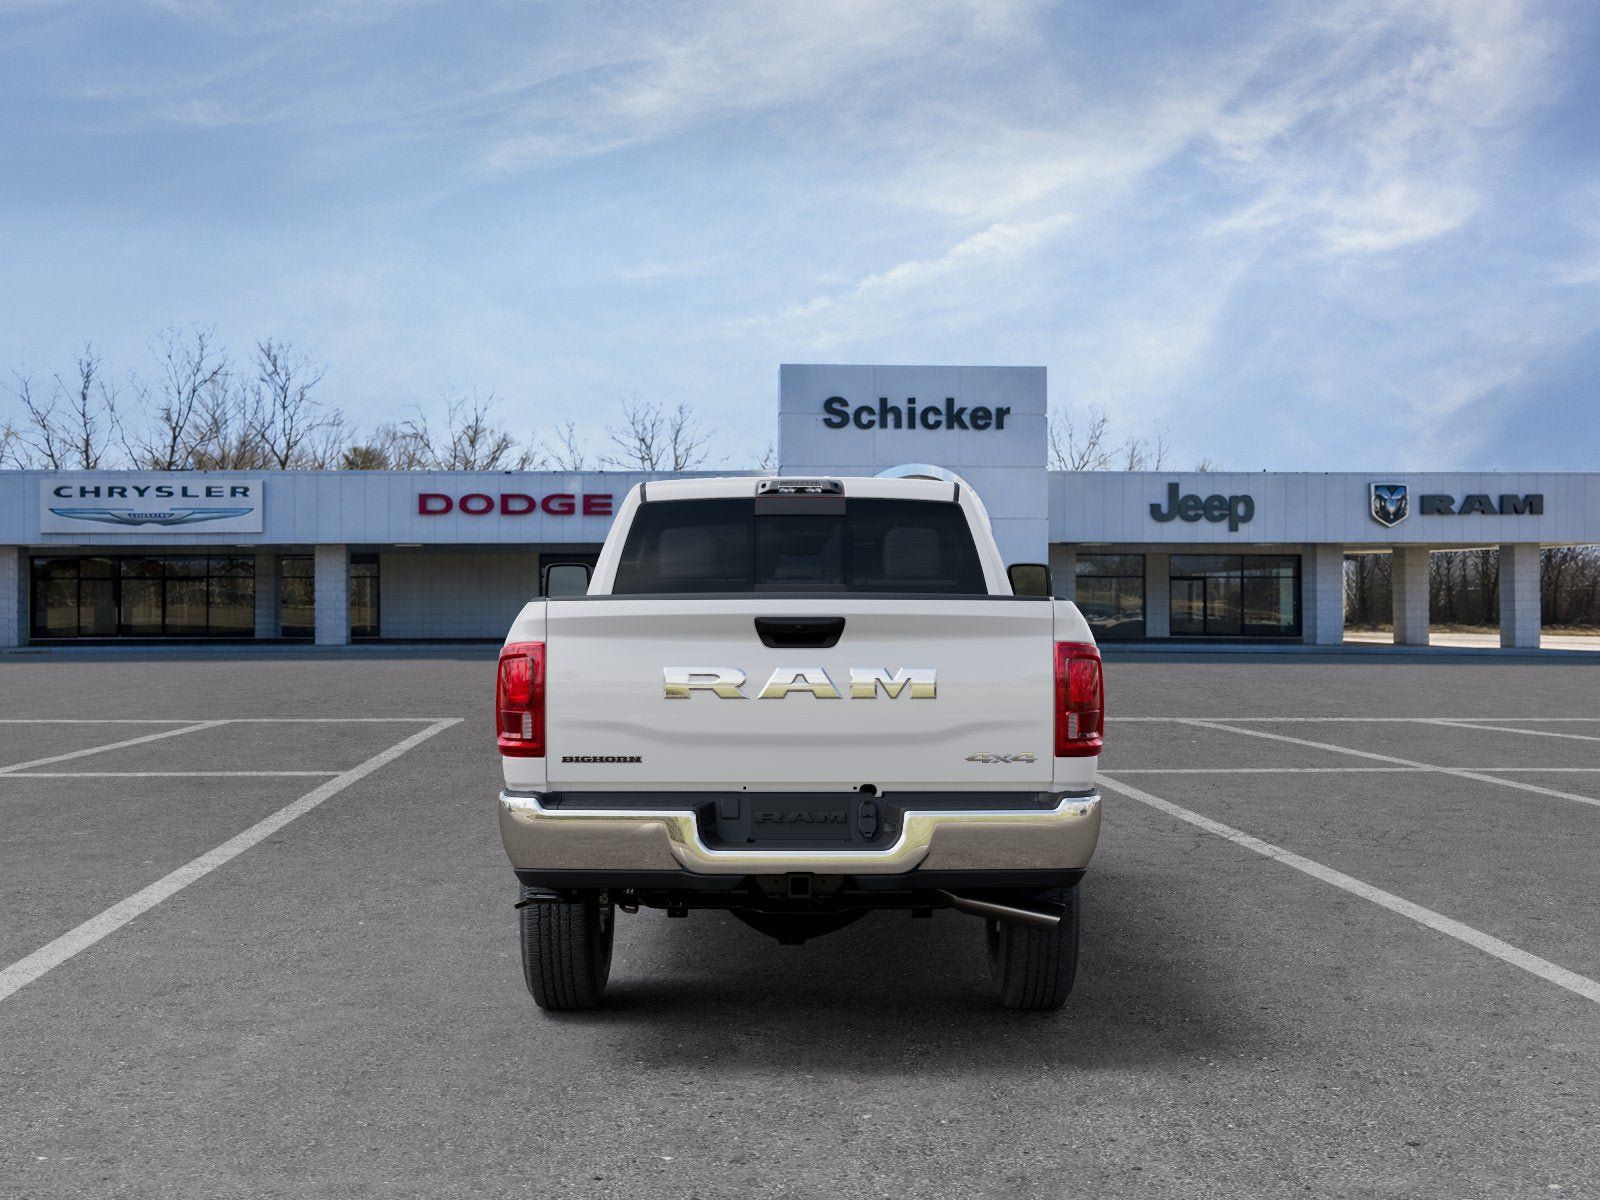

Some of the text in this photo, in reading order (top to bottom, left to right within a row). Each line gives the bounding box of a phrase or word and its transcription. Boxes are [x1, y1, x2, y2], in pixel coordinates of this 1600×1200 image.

[823, 396, 1010, 430] Schicker
[53, 485, 250, 499] CHRYSLER
[418, 493, 613, 516] DODGE
[1149, 482, 1255, 532] Jeep
[1419, 494, 1544, 516] RAM
[663, 666, 938, 700] RAM
[754, 810, 847, 824] RAM
